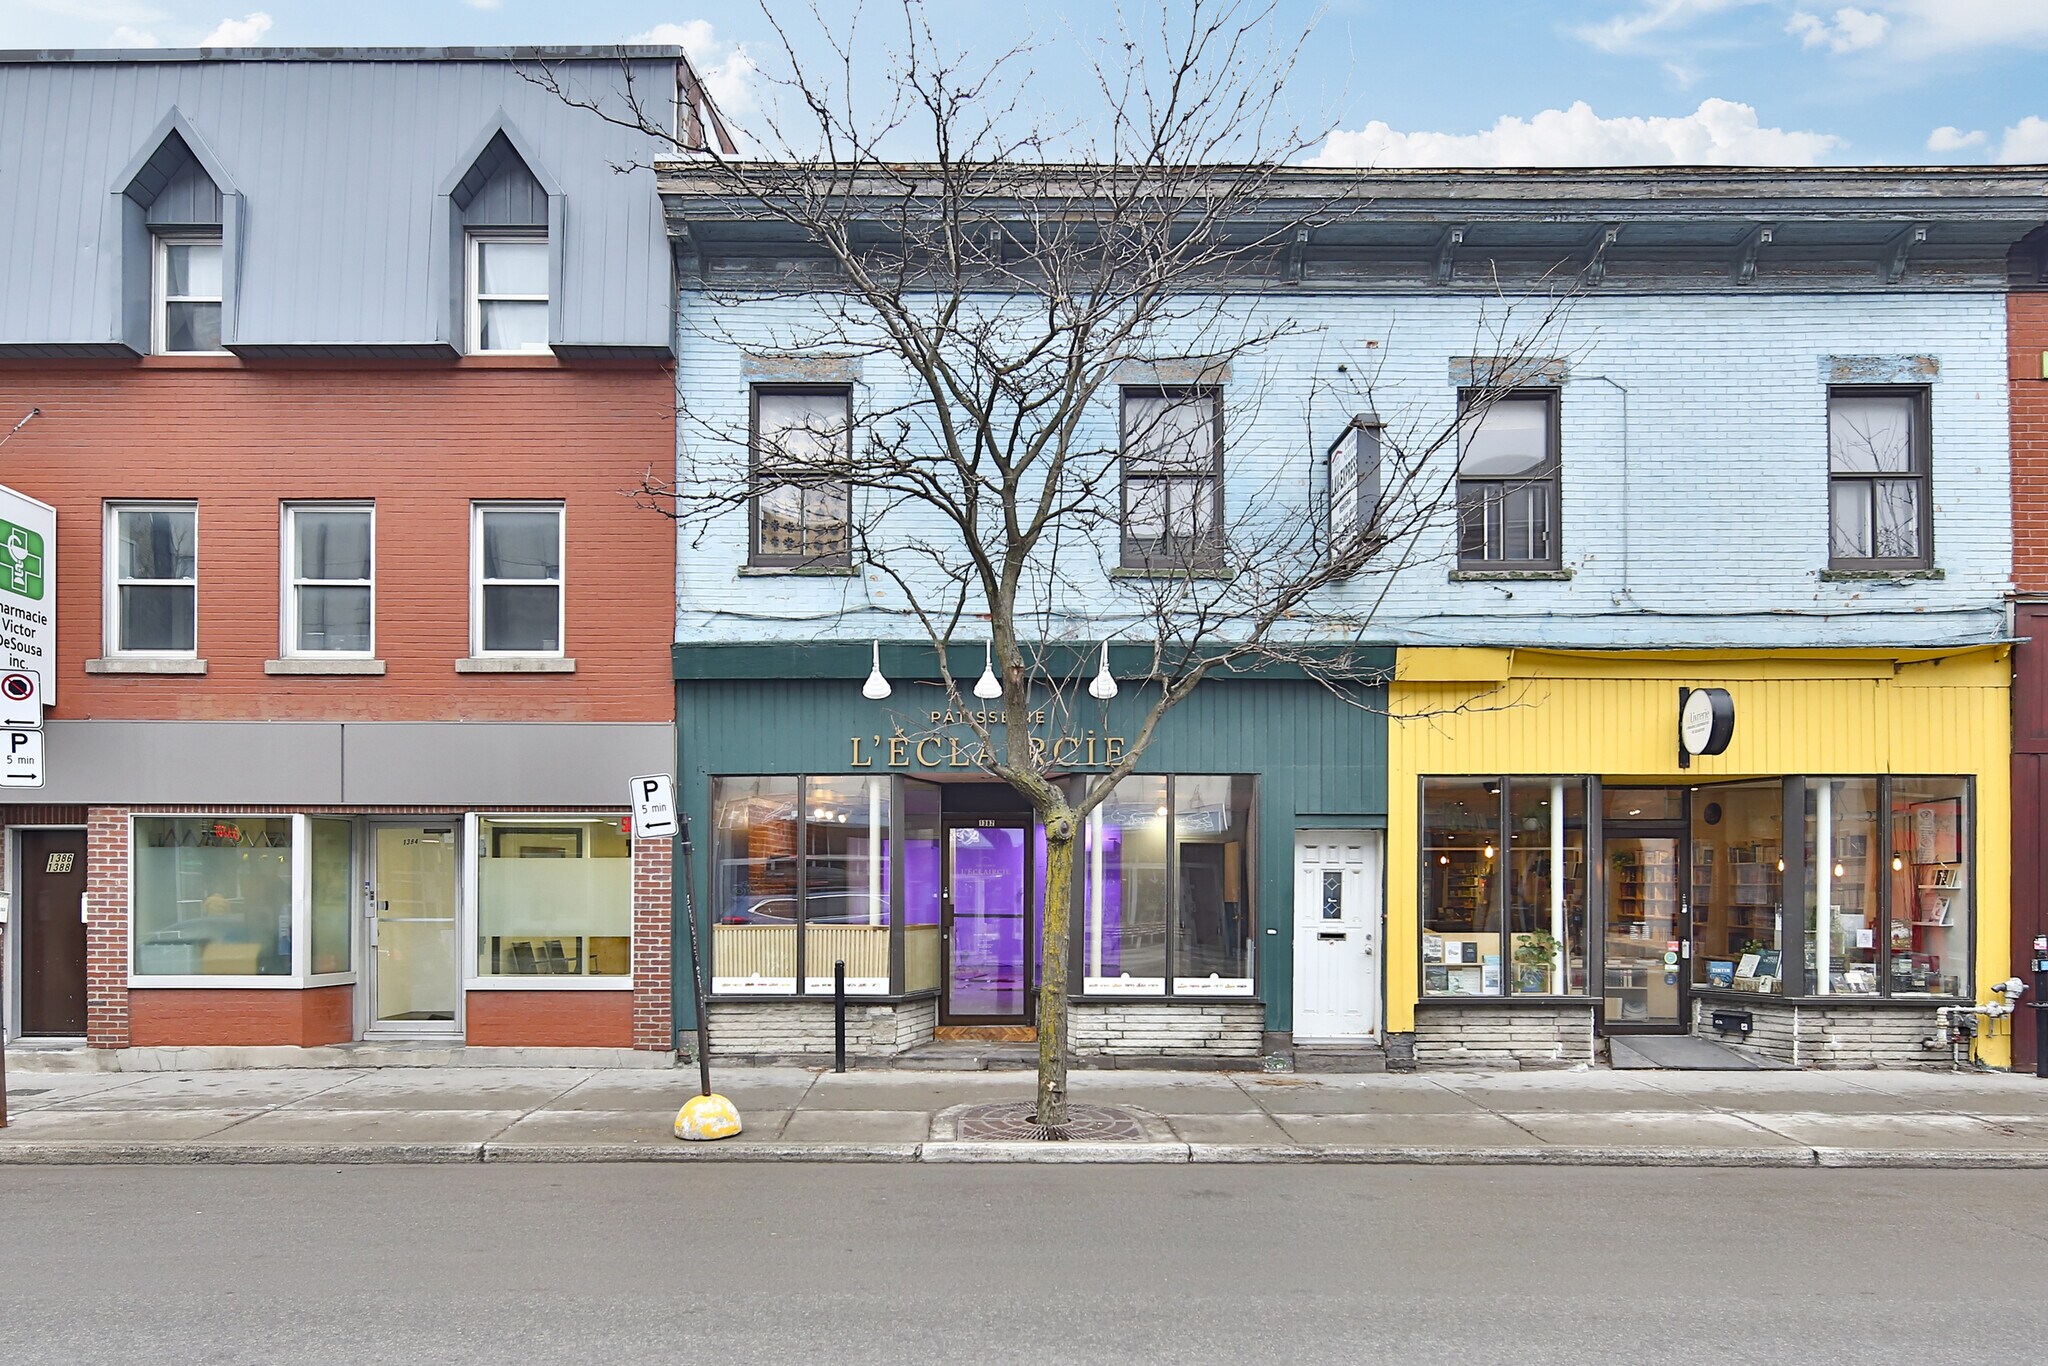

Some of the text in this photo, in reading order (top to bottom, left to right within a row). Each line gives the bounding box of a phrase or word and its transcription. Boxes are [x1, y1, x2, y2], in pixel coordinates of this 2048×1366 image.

[0, 603, 47, 626] armacie
[2, 617, 36, 638] Victor
[9, 653, 28, 669] inc.
[931, 709, 1045, 723] PÂTSSEIE
[12, 733, 28, 753] P
[7, 754, 35, 764] 5 min
[643, 780, 658, 802] P
[641, 803, 667, 814] 5 min
[50, 854, 73, 862] 1386
[48, 863, 71, 871] 1388
